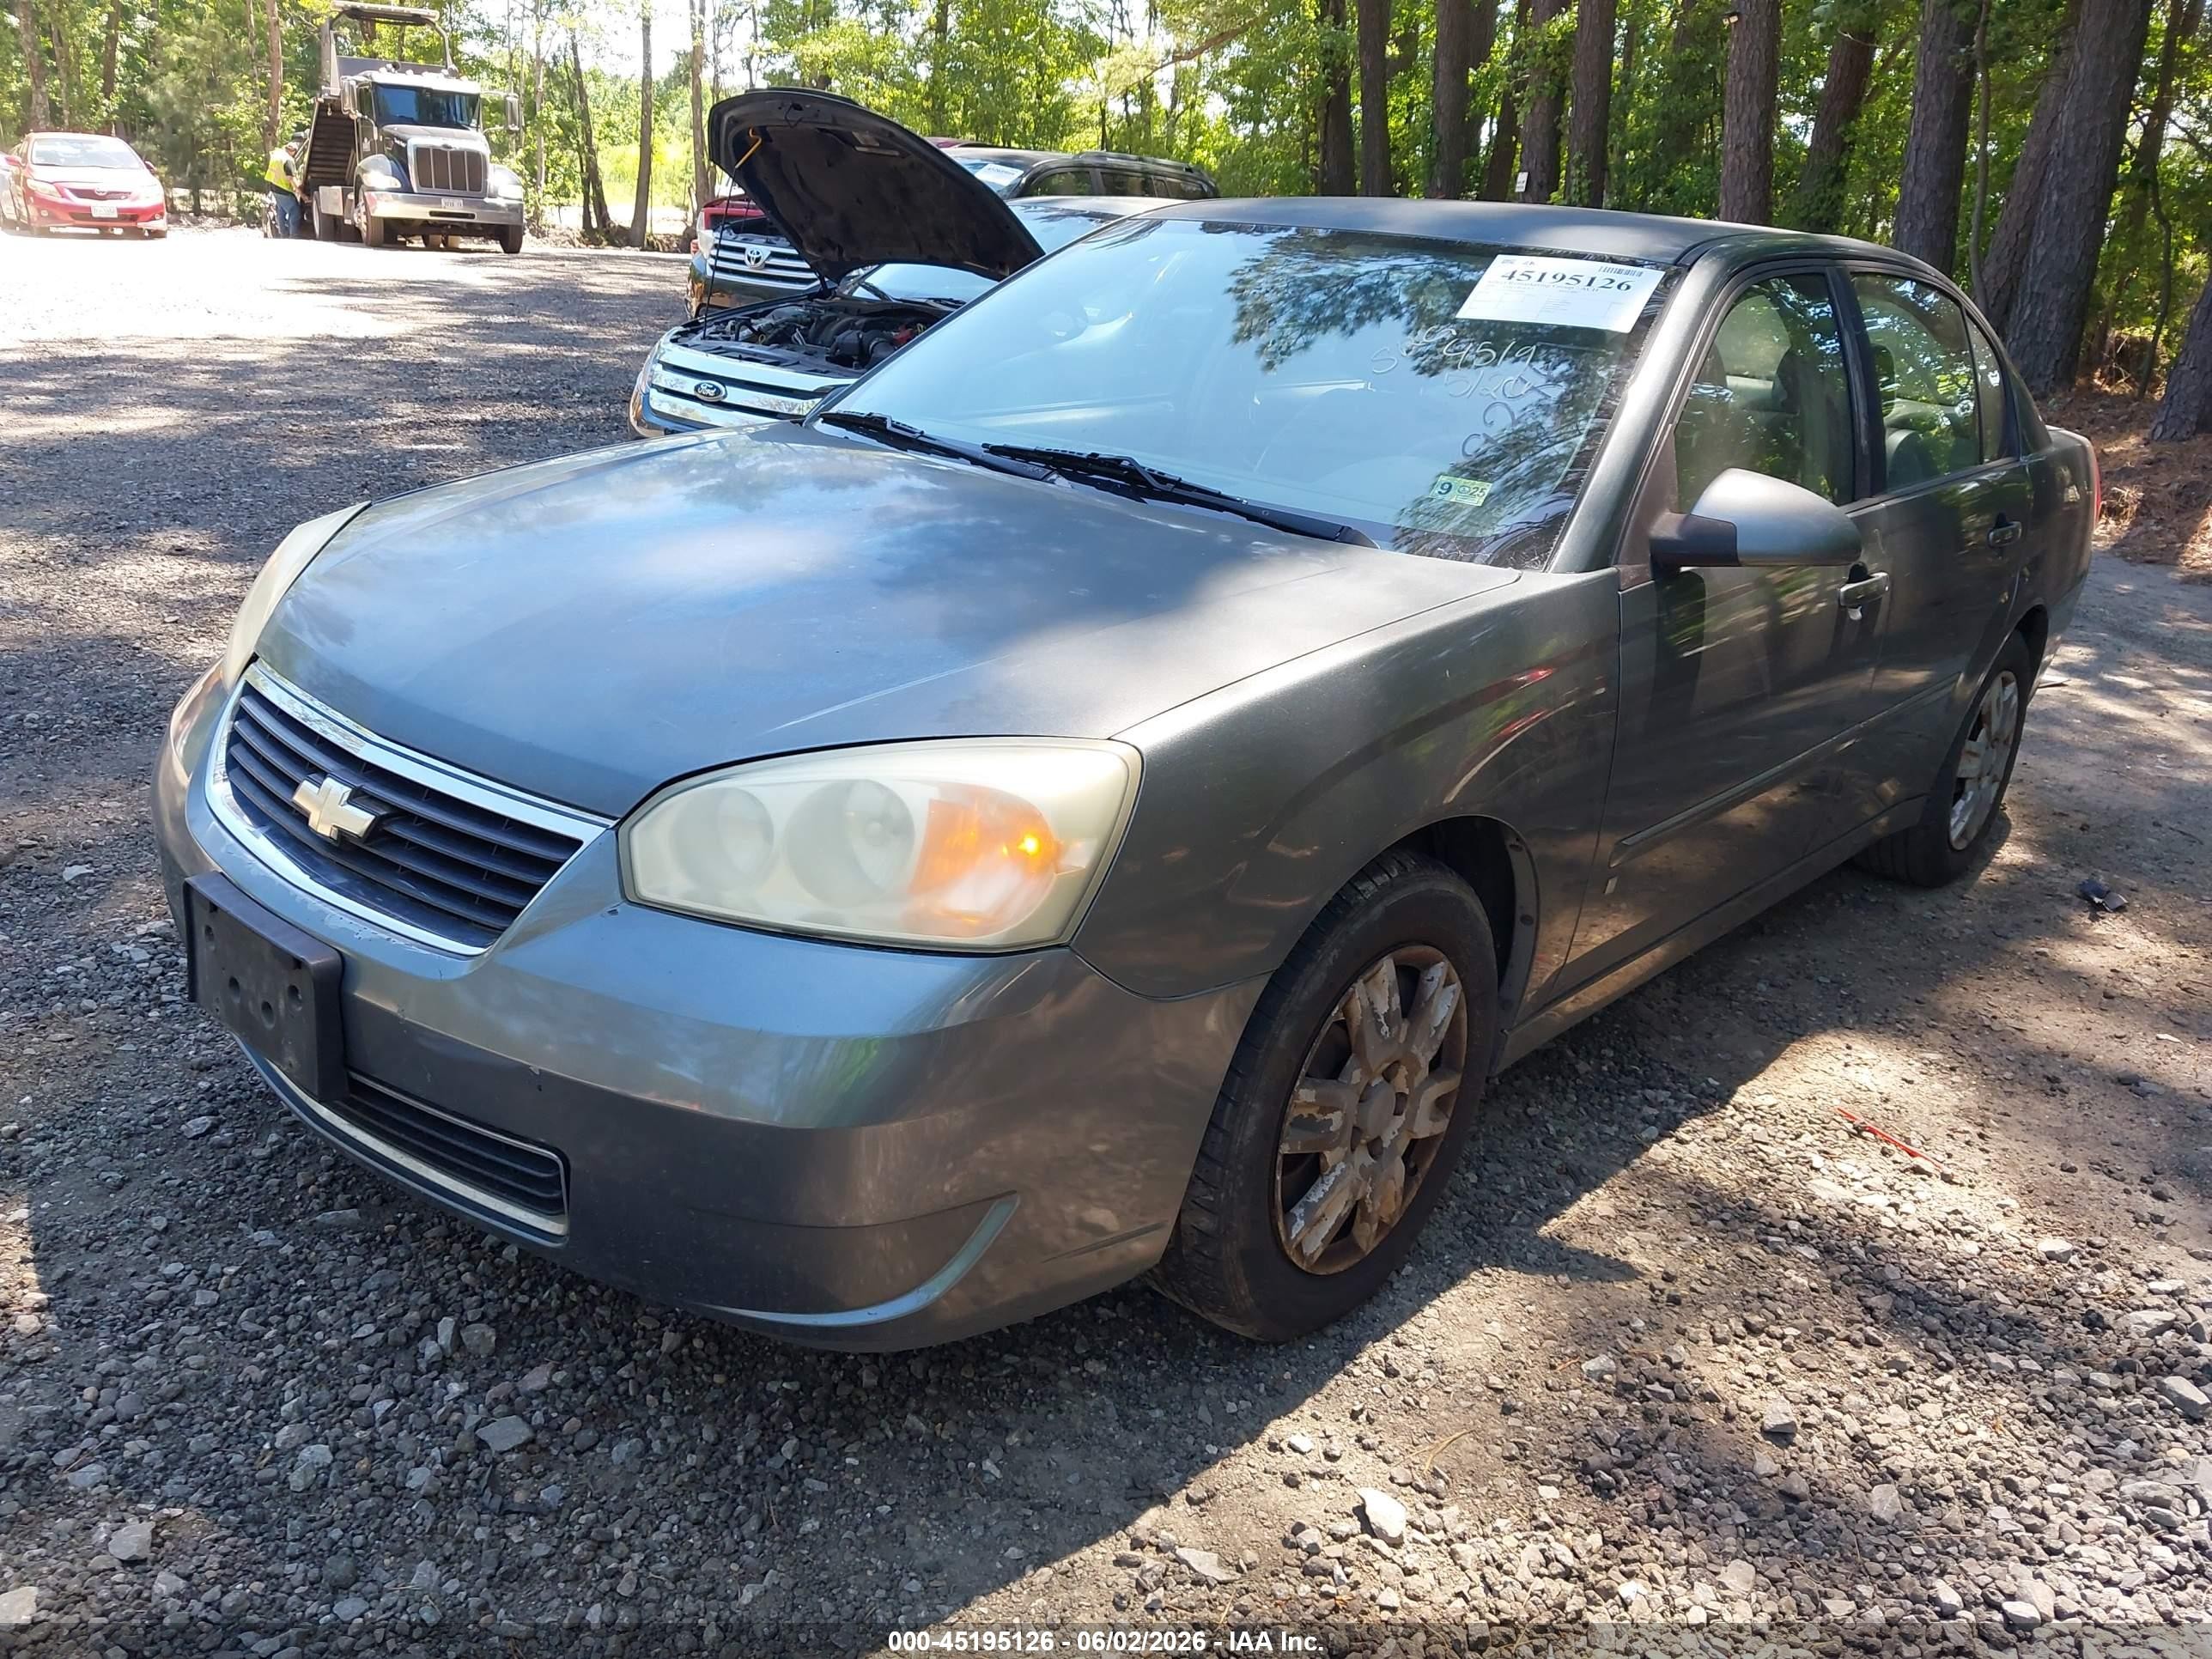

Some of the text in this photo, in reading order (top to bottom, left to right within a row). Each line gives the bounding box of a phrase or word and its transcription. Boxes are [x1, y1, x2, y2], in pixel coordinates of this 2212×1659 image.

[1501, 270, 1635, 292] 45195126
[1443, 338, 1536, 369] 4519
[697, 383, 717, 396] Ford
[1437, 482, 1487, 497] 9 25
